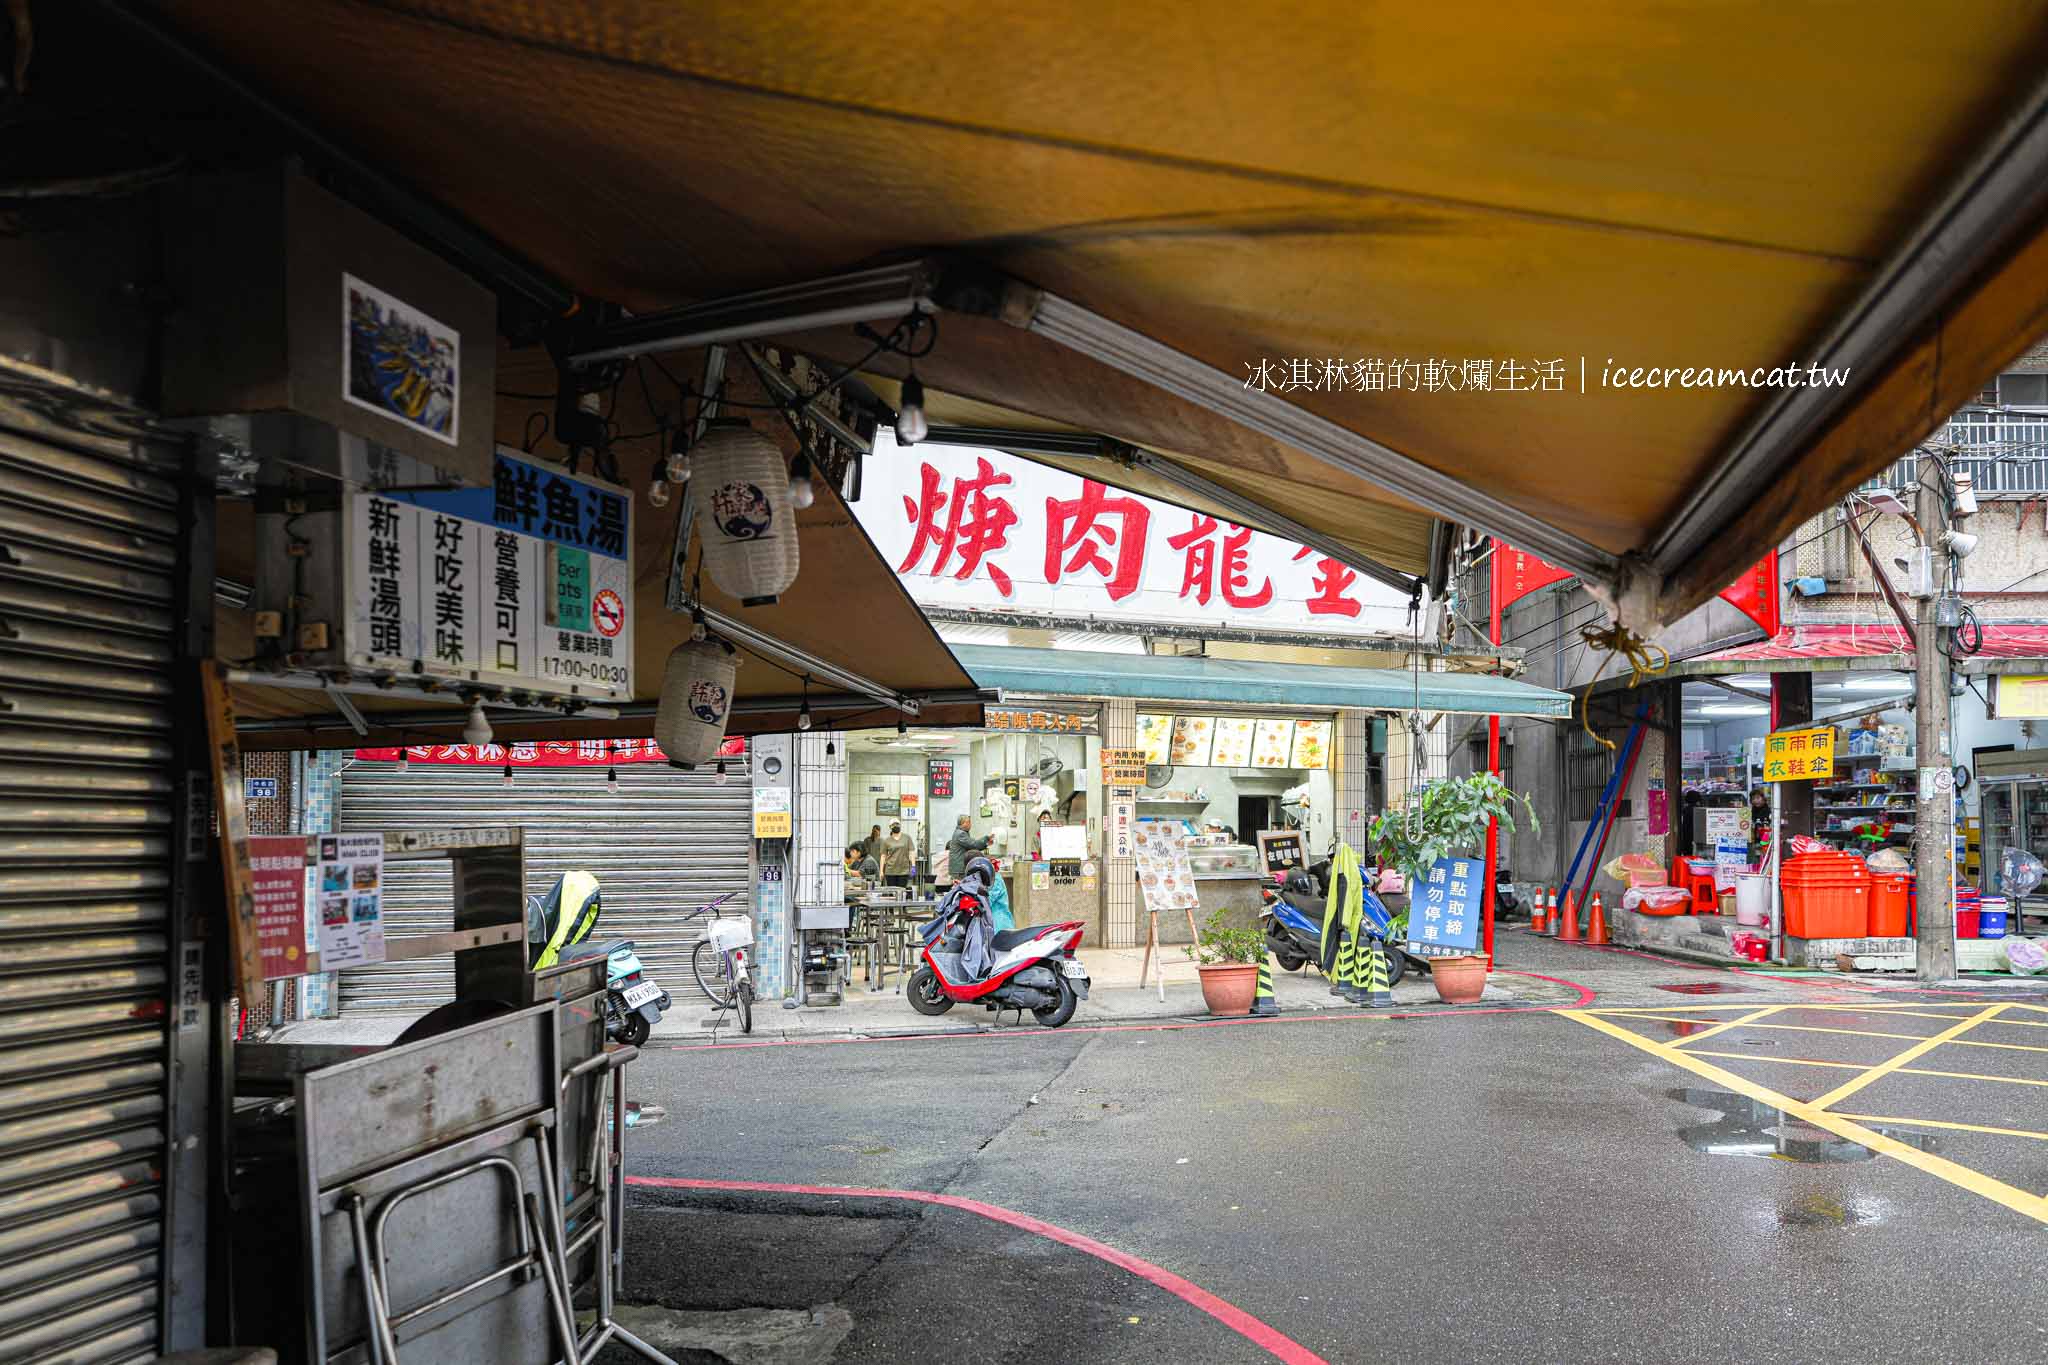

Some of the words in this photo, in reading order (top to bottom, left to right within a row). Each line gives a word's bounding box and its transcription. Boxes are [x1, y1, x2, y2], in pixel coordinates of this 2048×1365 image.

[494, 459, 626, 556] 鮮魚湯
[368, 498, 402, 657] 新鮮湯頭
[434, 515, 464, 665] 好吃美味
[495, 531, 520, 672] 營養可口
[557, 631, 614, 658] 營業時間
[1810, 733, 1828, 774] 雨傘
[766, 872, 779, 881] 96
[1054, 877, 1075, 885] order
[1423, 867, 1446, 943] 請勿停車
[1445, 861, 1470, 936] 重點取締
